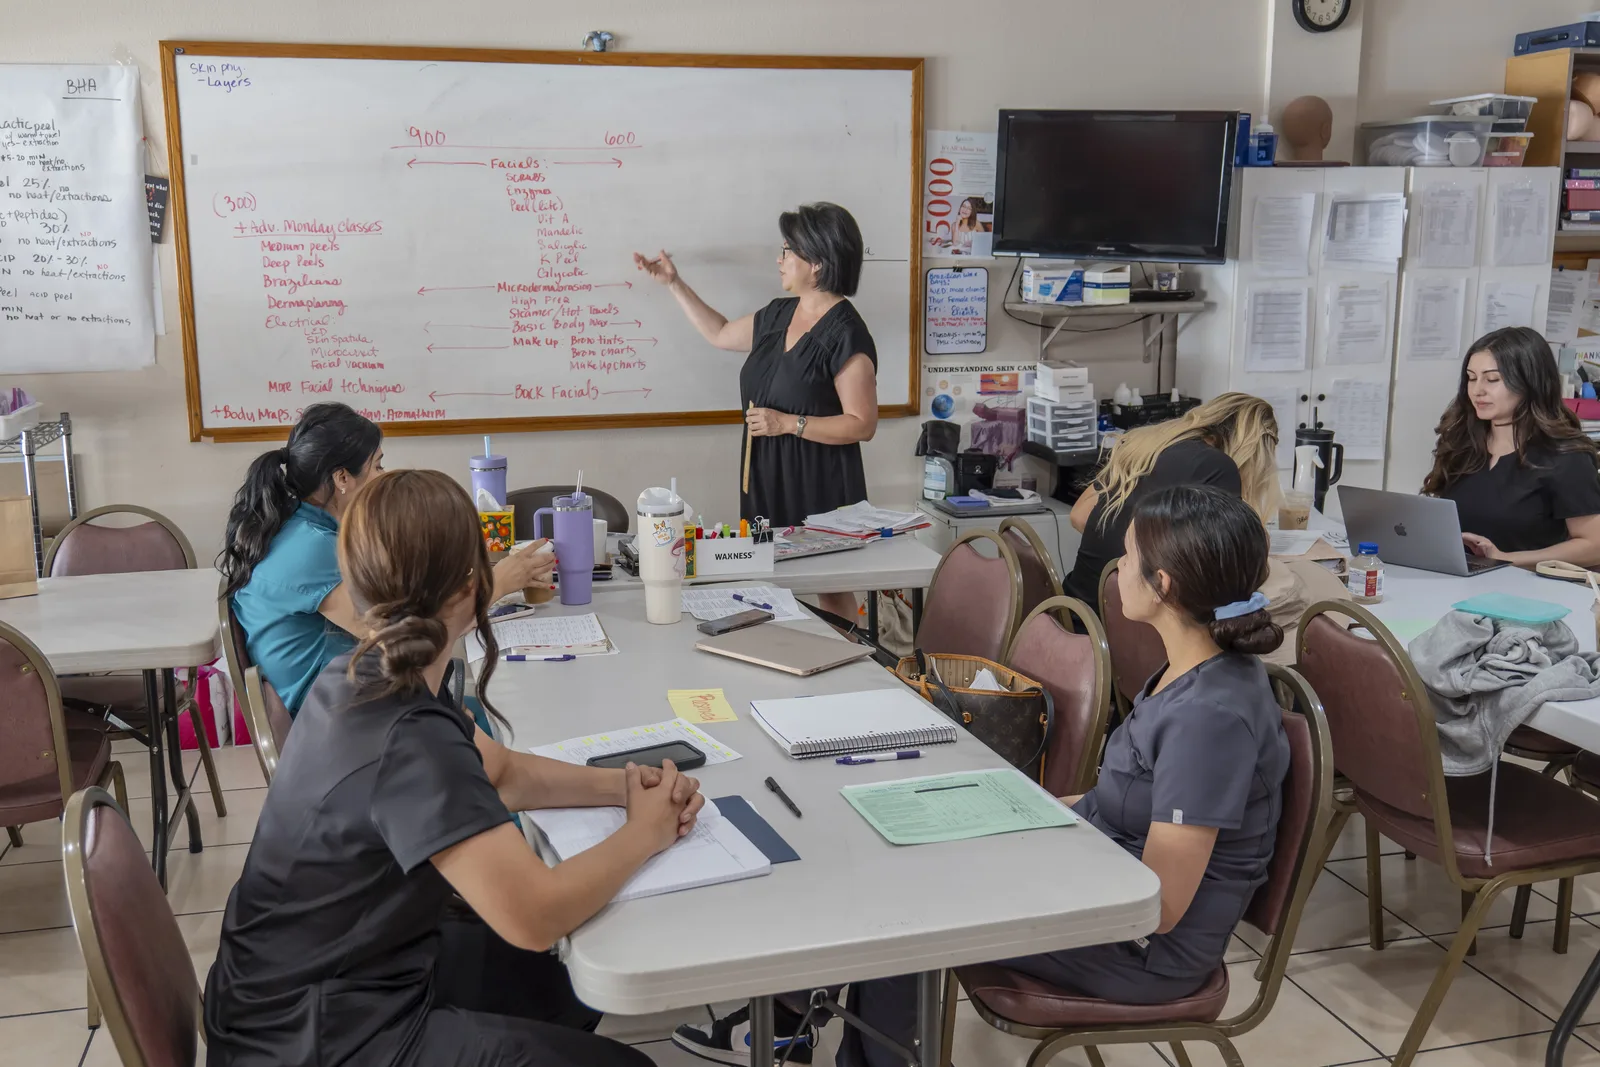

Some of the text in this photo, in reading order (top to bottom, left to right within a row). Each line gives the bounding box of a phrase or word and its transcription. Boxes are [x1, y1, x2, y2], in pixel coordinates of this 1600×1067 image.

[66, 78, 97, 94] BHA
[34, 118, 55, 133] peel
[23, 139, 59, 147] extraction
[409, 126, 446, 147] 900
[604, 131, 636, 146] 600
[42, 163, 85, 172] extractions
[23, 177, 51, 190] 25%
[59, 185, 70, 193] no
[212, 192, 257, 218] (300)
[926, 157, 955, 247] $5000
[562, 212, 569, 224] A
[40, 222, 70, 234] 30%
[283, 218, 337, 242] Monday
[536, 225, 584, 237] Mandelic
[309, 242, 340, 257] peels
[537, 239, 587, 254] Salicylic
[33, 254, 54, 264] 20%
[66, 255, 88, 267] 30%
[263, 253, 325, 274] Deep Peels
[540, 252, 579, 265] K Peel
[263, 273, 343, 295] Brazilians
[54, 292, 73, 302] peel
[511, 297, 537, 310] High
[267, 294, 349, 316] Dermaplaning
[586, 302, 620, 316] Towels
[81, 314, 131, 326] extractions
[511, 319, 547, 334] Basic
[553, 318, 586, 334] Body
[304, 327, 328, 336] LED
[306, 335, 330, 344] Skin
[513, 335, 542, 347] Make
[570, 335, 595, 346] Brow
[598, 334, 625, 345] tints
[571, 347, 597, 359] Brow
[311, 357, 341, 370] Facial
[268, 378, 406, 404] More Facial techniques
[514, 378, 600, 400] Back Facials
[715, 551, 753, 560] WAXNESS
